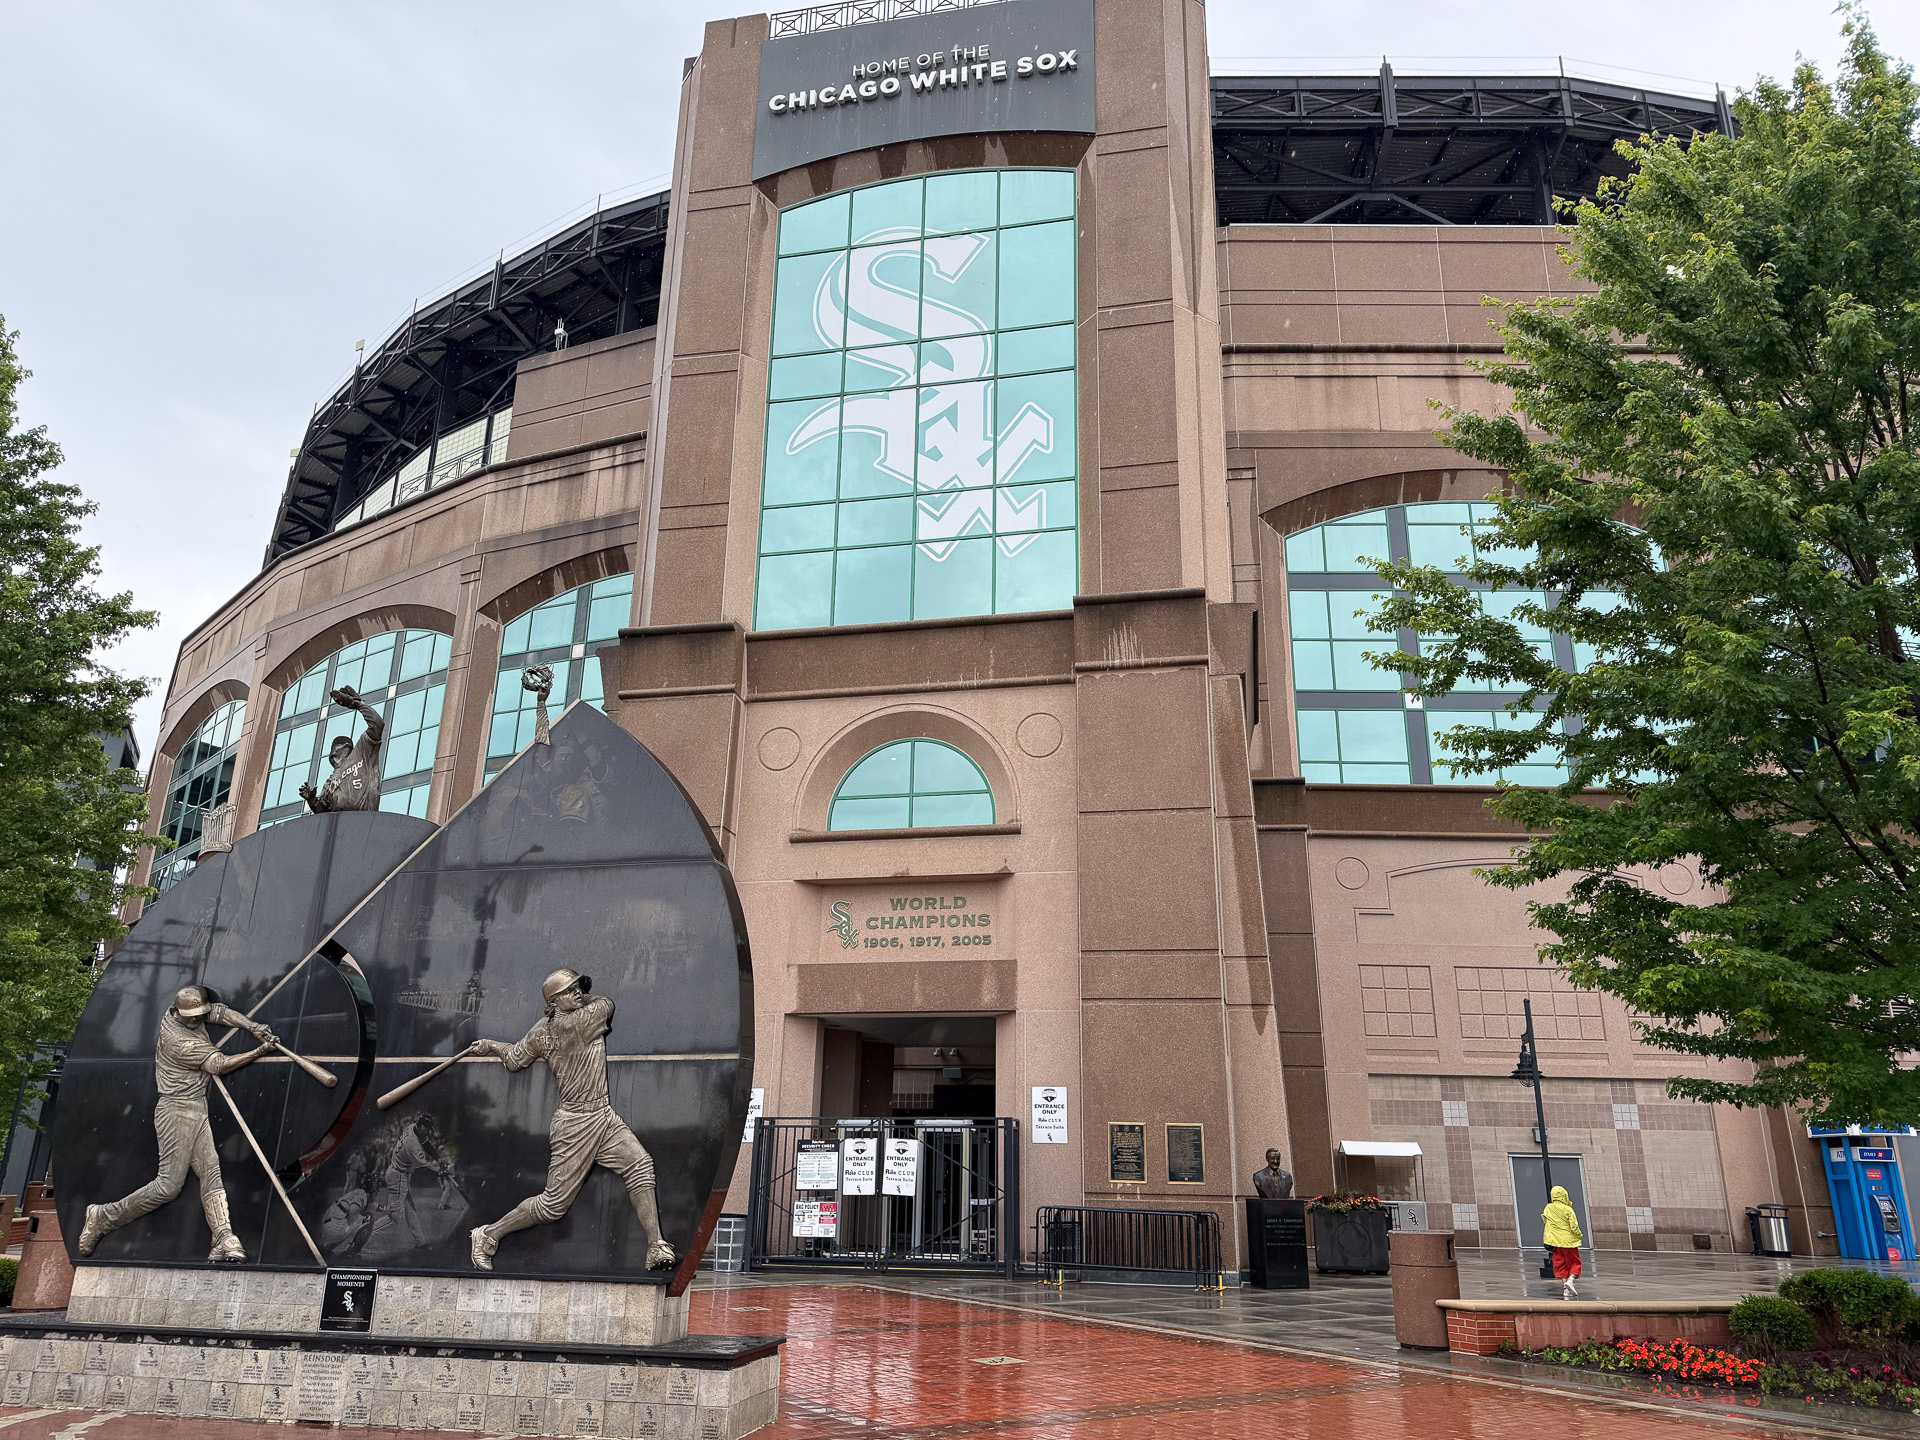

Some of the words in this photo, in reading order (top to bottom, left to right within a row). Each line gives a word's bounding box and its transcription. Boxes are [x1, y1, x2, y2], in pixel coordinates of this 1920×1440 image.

[853, 56, 910, 80] HOME
[916, 51, 944, 69] OF
[951, 44, 990, 61] THE
[768, 76, 900, 114] CHICAGO
[910, 59, 1007, 93] WHITE
[1016, 49, 1078, 77] SOX
[352, 779, 362, 789] 5
[889, 896, 967, 911] WORLD
[866, 913, 991, 930] CHAMPIONS
[863, 937, 904, 949] 1906,
[910, 936, 946, 949] 1917,
[951, 935, 992, 946] 2005
[1836, 1150, 1845, 1159] AT
[330, 1273, 373, 1281] CHAMPIONSHIP
